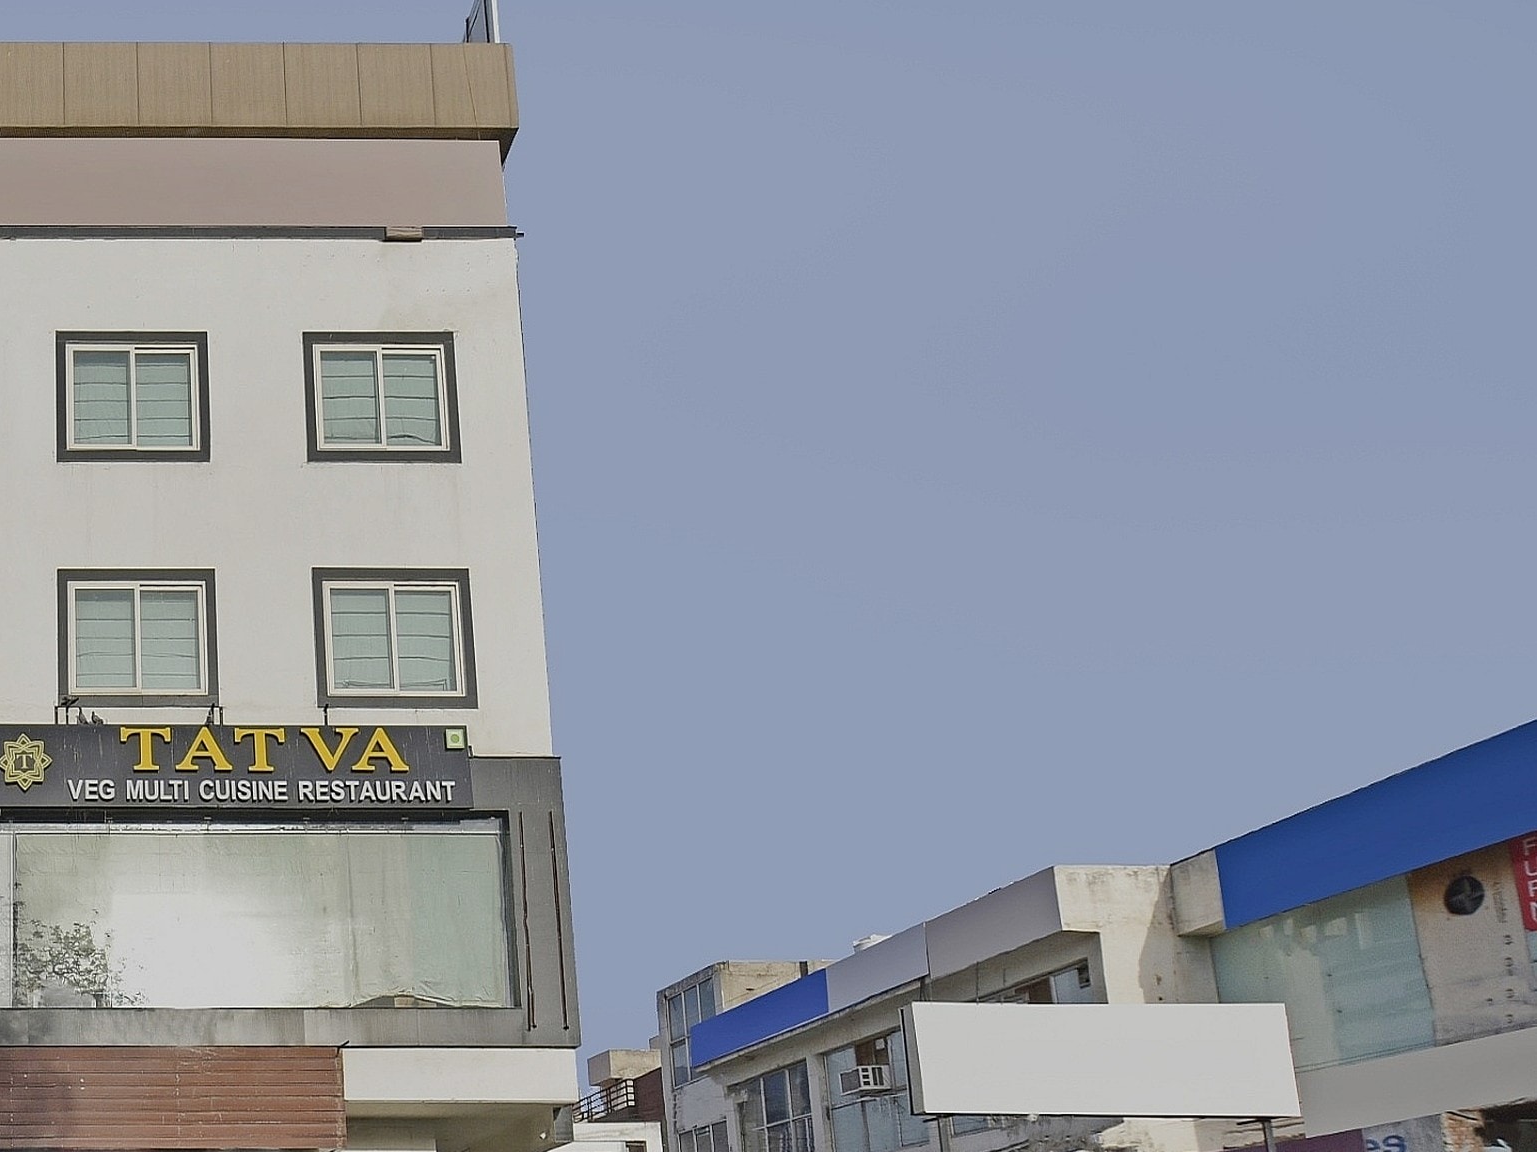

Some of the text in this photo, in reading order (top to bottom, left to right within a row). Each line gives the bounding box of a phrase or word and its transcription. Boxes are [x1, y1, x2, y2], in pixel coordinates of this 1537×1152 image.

[120, 726, 410, 772] TATVA
[67, 779, 456, 803] VEG MULTI CUISINE RESTAURANT
